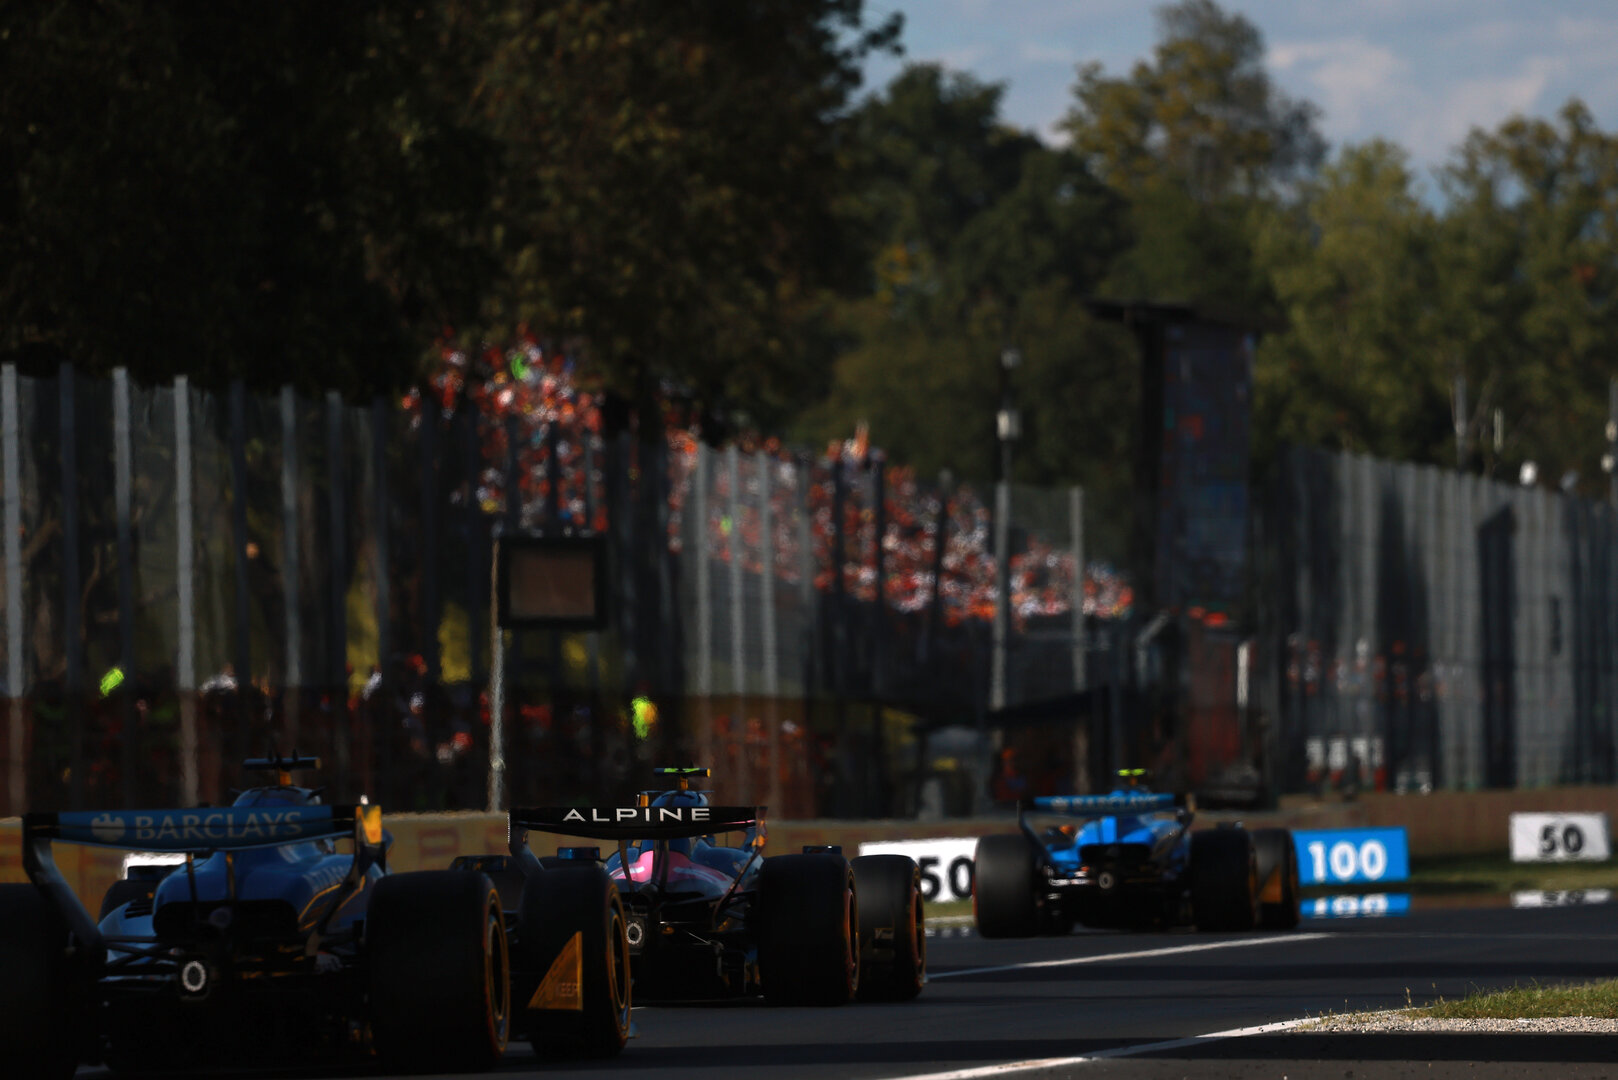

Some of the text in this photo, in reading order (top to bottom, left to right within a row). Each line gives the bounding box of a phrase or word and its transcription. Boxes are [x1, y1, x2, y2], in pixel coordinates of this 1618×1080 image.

[135, 811, 304, 841] BARCLAYS
[562, 807, 710, 822] ALPINE
[1542, 822, 1585, 854] 50
[1308, 838, 1387, 883] 100
[917, 855, 976, 902] 50
